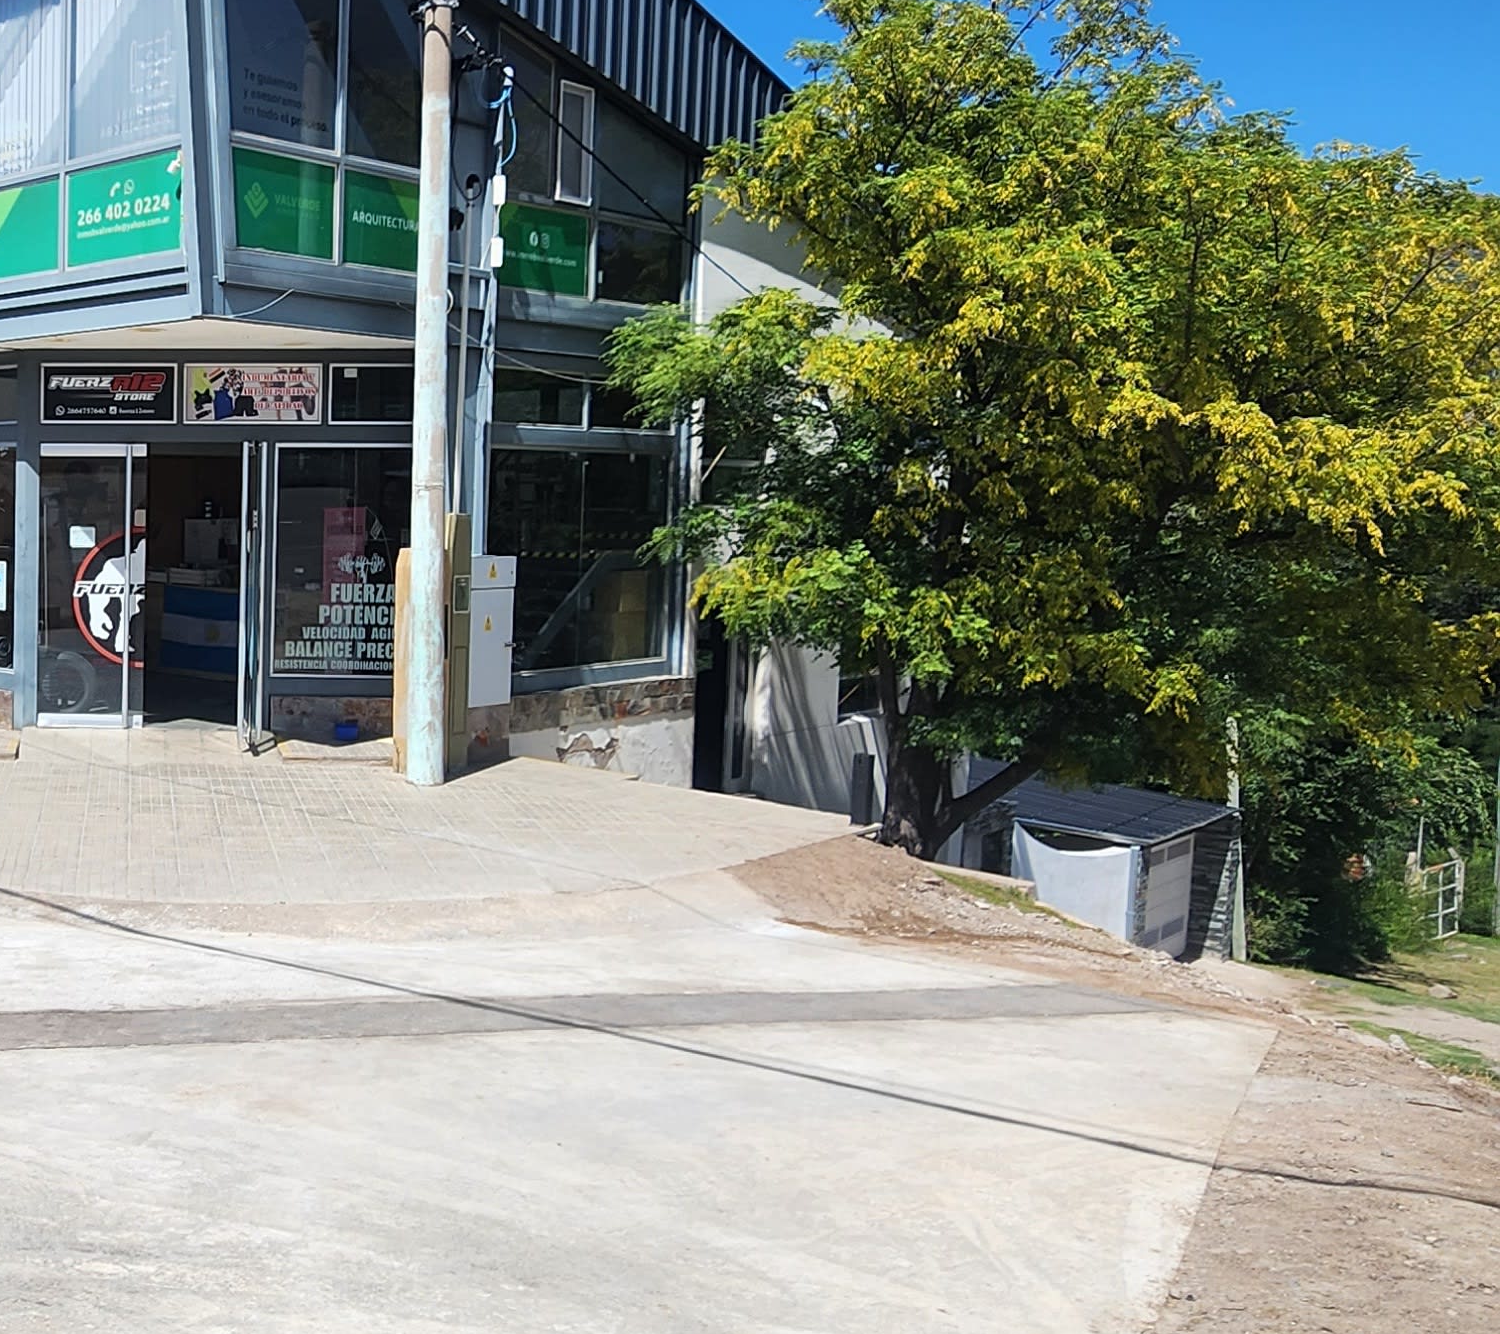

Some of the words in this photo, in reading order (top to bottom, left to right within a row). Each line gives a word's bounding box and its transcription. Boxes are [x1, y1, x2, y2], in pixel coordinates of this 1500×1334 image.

[77, 207, 102, 227] 266
[105, 200, 131, 221] 402
[133, 192, 170, 216] 0224
[113, 393, 156, 401] STORE
[330, 583, 395, 603] FUERZA
[318, 605, 394, 625] POTENCI
[302, 627, 366, 639] VELOCIDAD
[284, 641, 352, 657] BALANCE
[274, 659, 328, 669] RESISTENCIA
